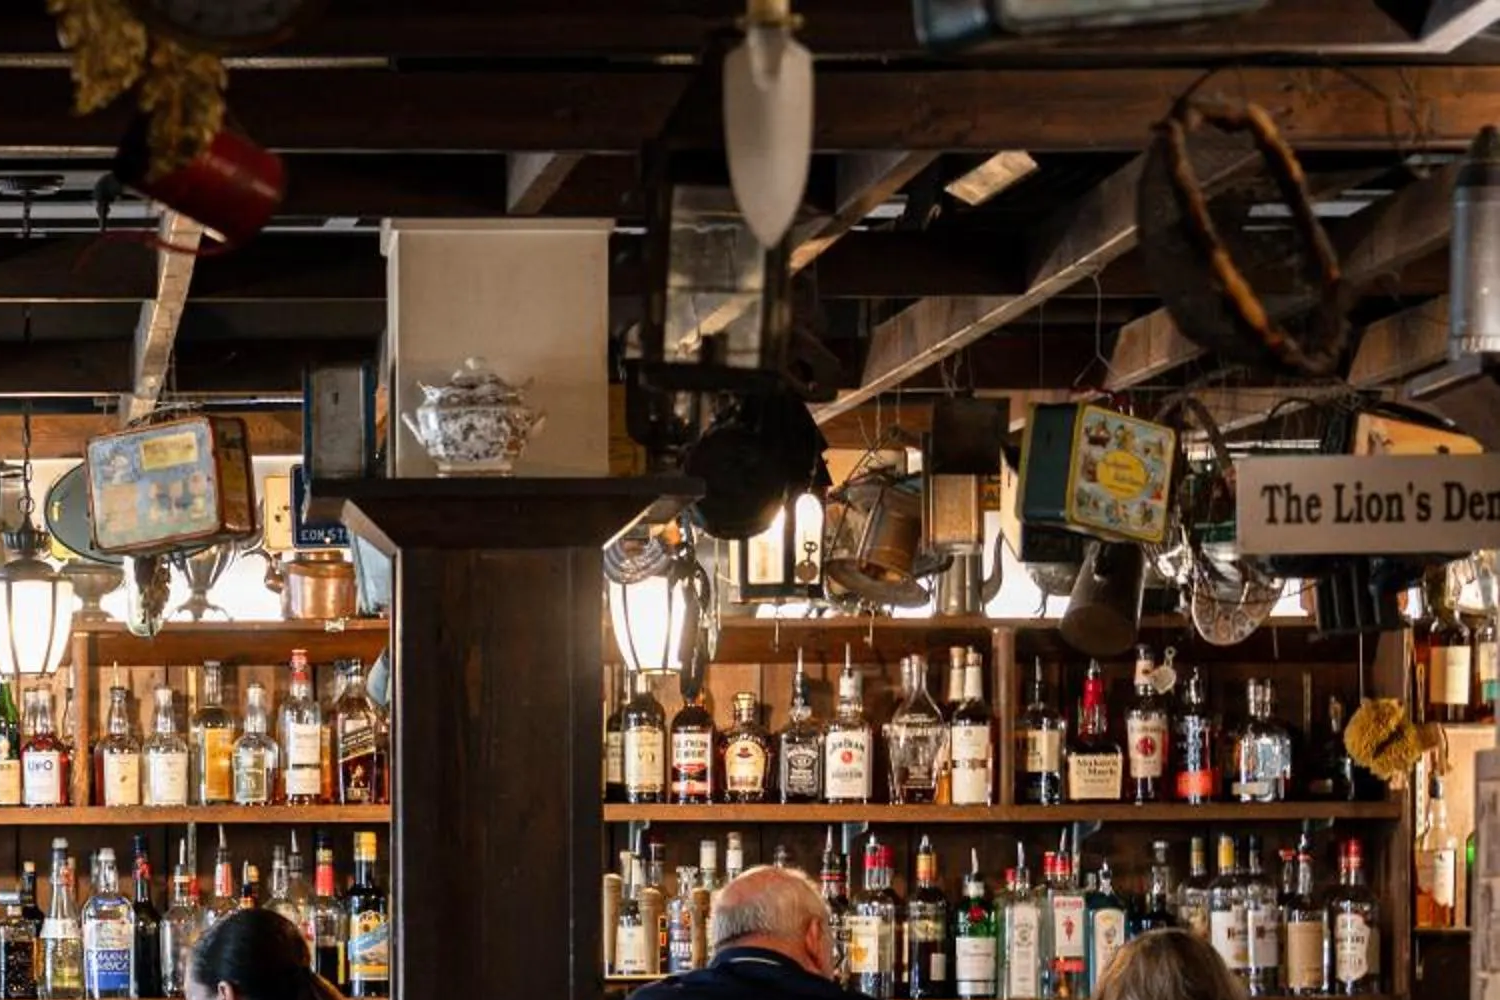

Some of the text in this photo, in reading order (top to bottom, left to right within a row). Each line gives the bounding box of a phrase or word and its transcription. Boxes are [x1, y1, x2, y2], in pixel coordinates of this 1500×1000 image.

[1261, 482, 1500, 525] The Lion's Den
